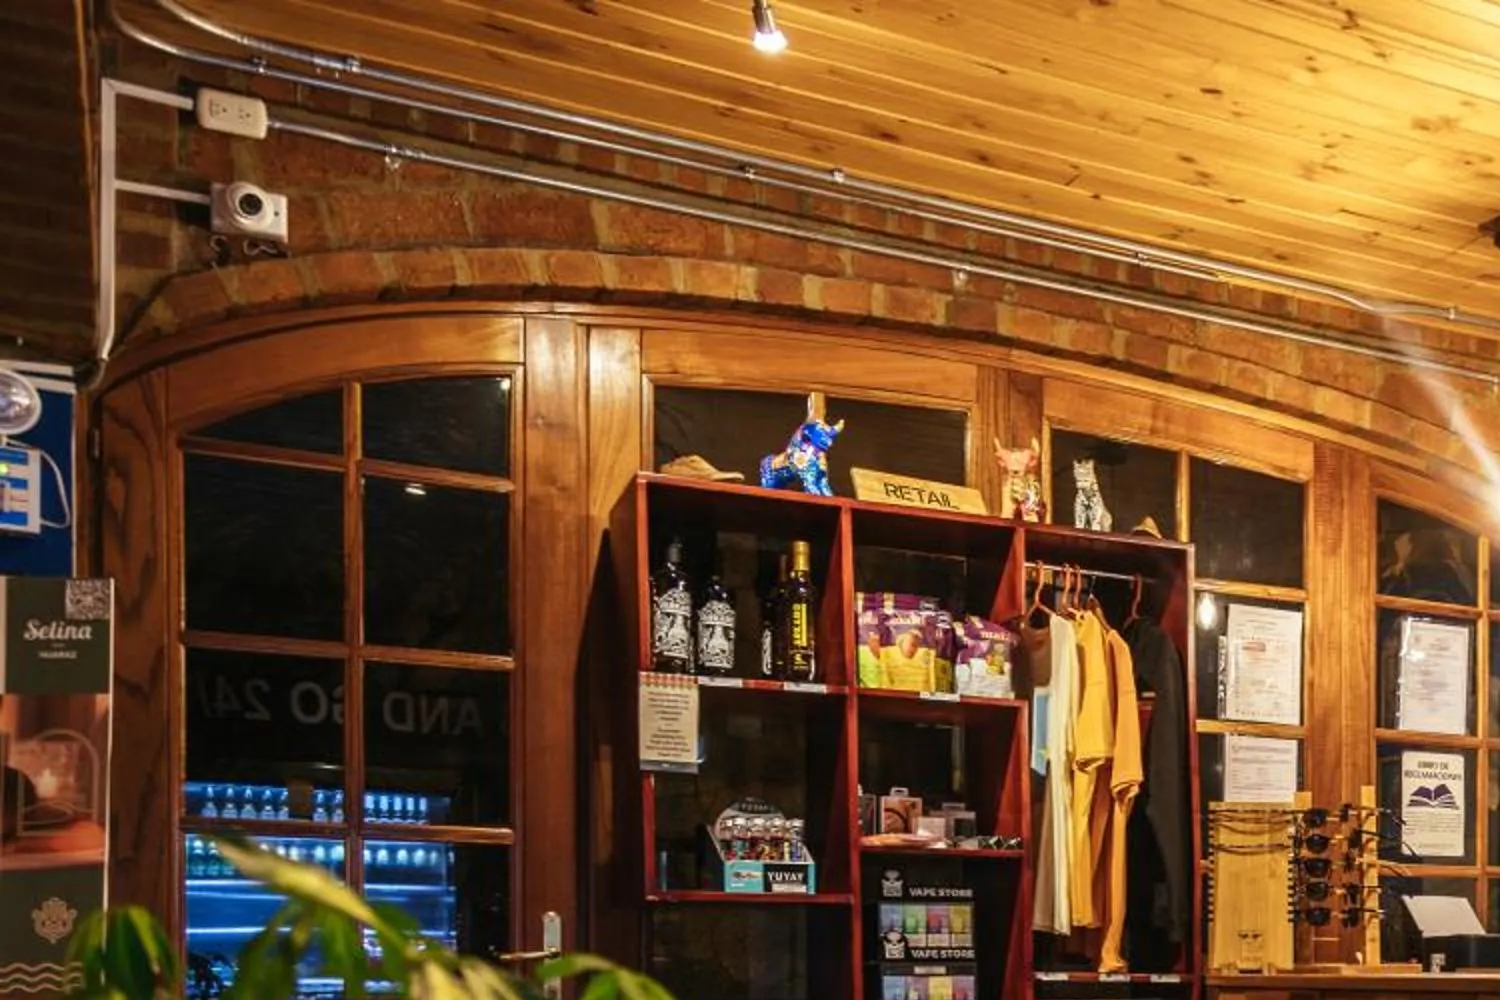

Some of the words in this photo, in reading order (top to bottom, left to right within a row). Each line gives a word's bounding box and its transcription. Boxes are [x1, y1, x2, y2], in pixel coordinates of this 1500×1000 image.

[883, 482, 960, 510] RETAIL
[23, 619, 93, 640] Selina
[909, 887, 938, 897] VAPE
[938, 888, 973, 898] STORE
[911, 949, 939, 959] VAPE
[940, 950, 975, 959] STORE
